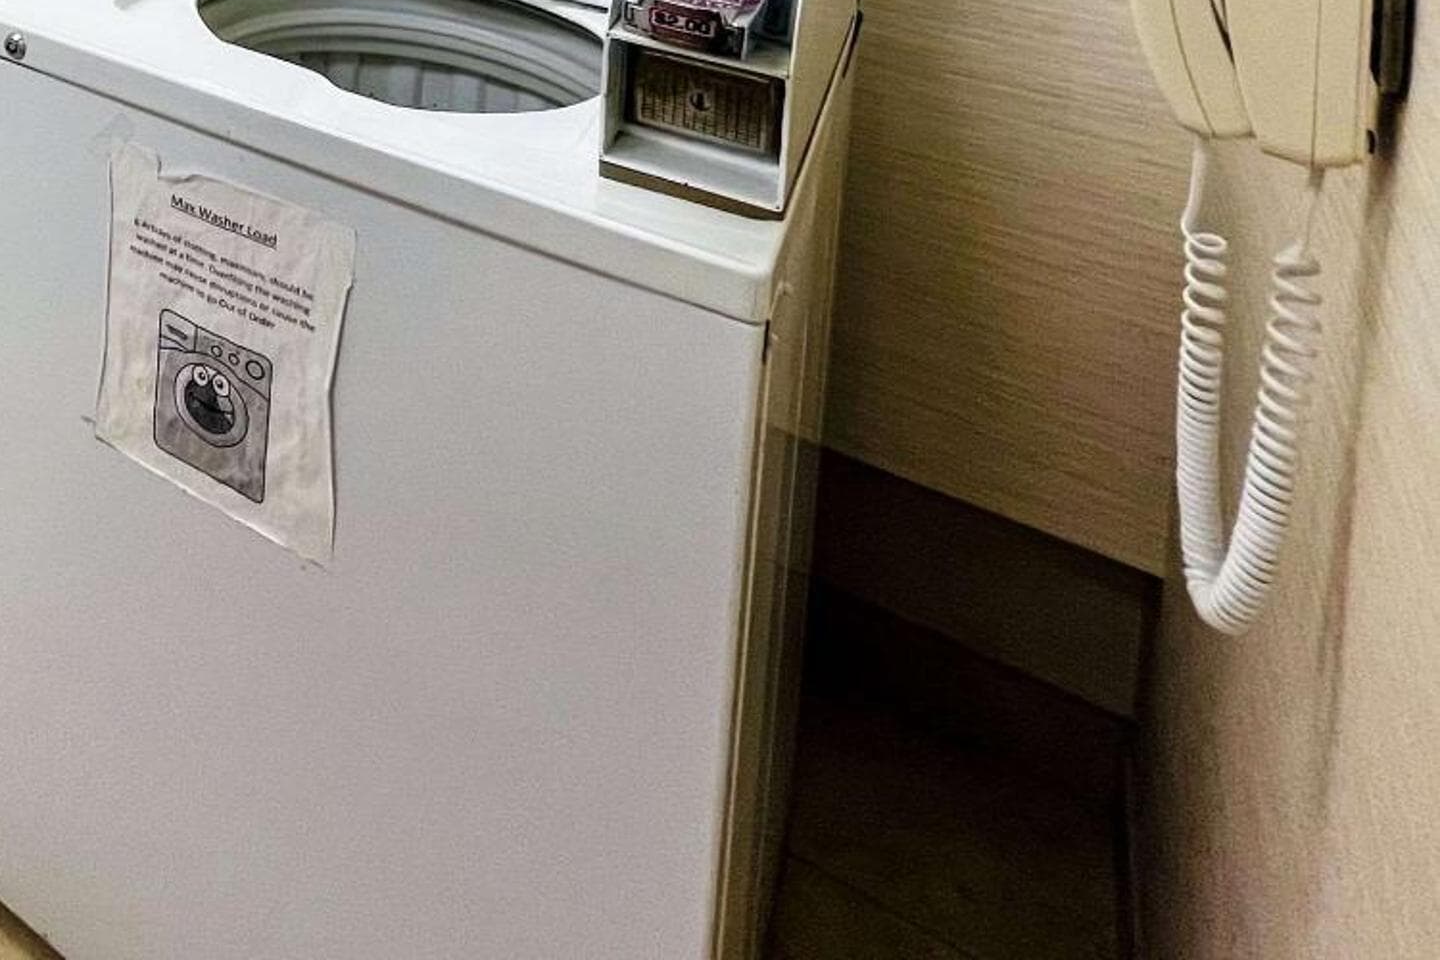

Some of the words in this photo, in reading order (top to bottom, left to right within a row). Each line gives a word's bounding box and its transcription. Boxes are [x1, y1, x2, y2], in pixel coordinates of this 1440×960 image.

[170, 193, 195, 213] Max
[198, 205, 245, 232] Washer
[247, 225, 277, 248] Load
[269, 276, 300, 296] should
[218, 298, 236, 312] Out
[248, 311, 276, 329] Order
[272, 294, 310, 318] washing
